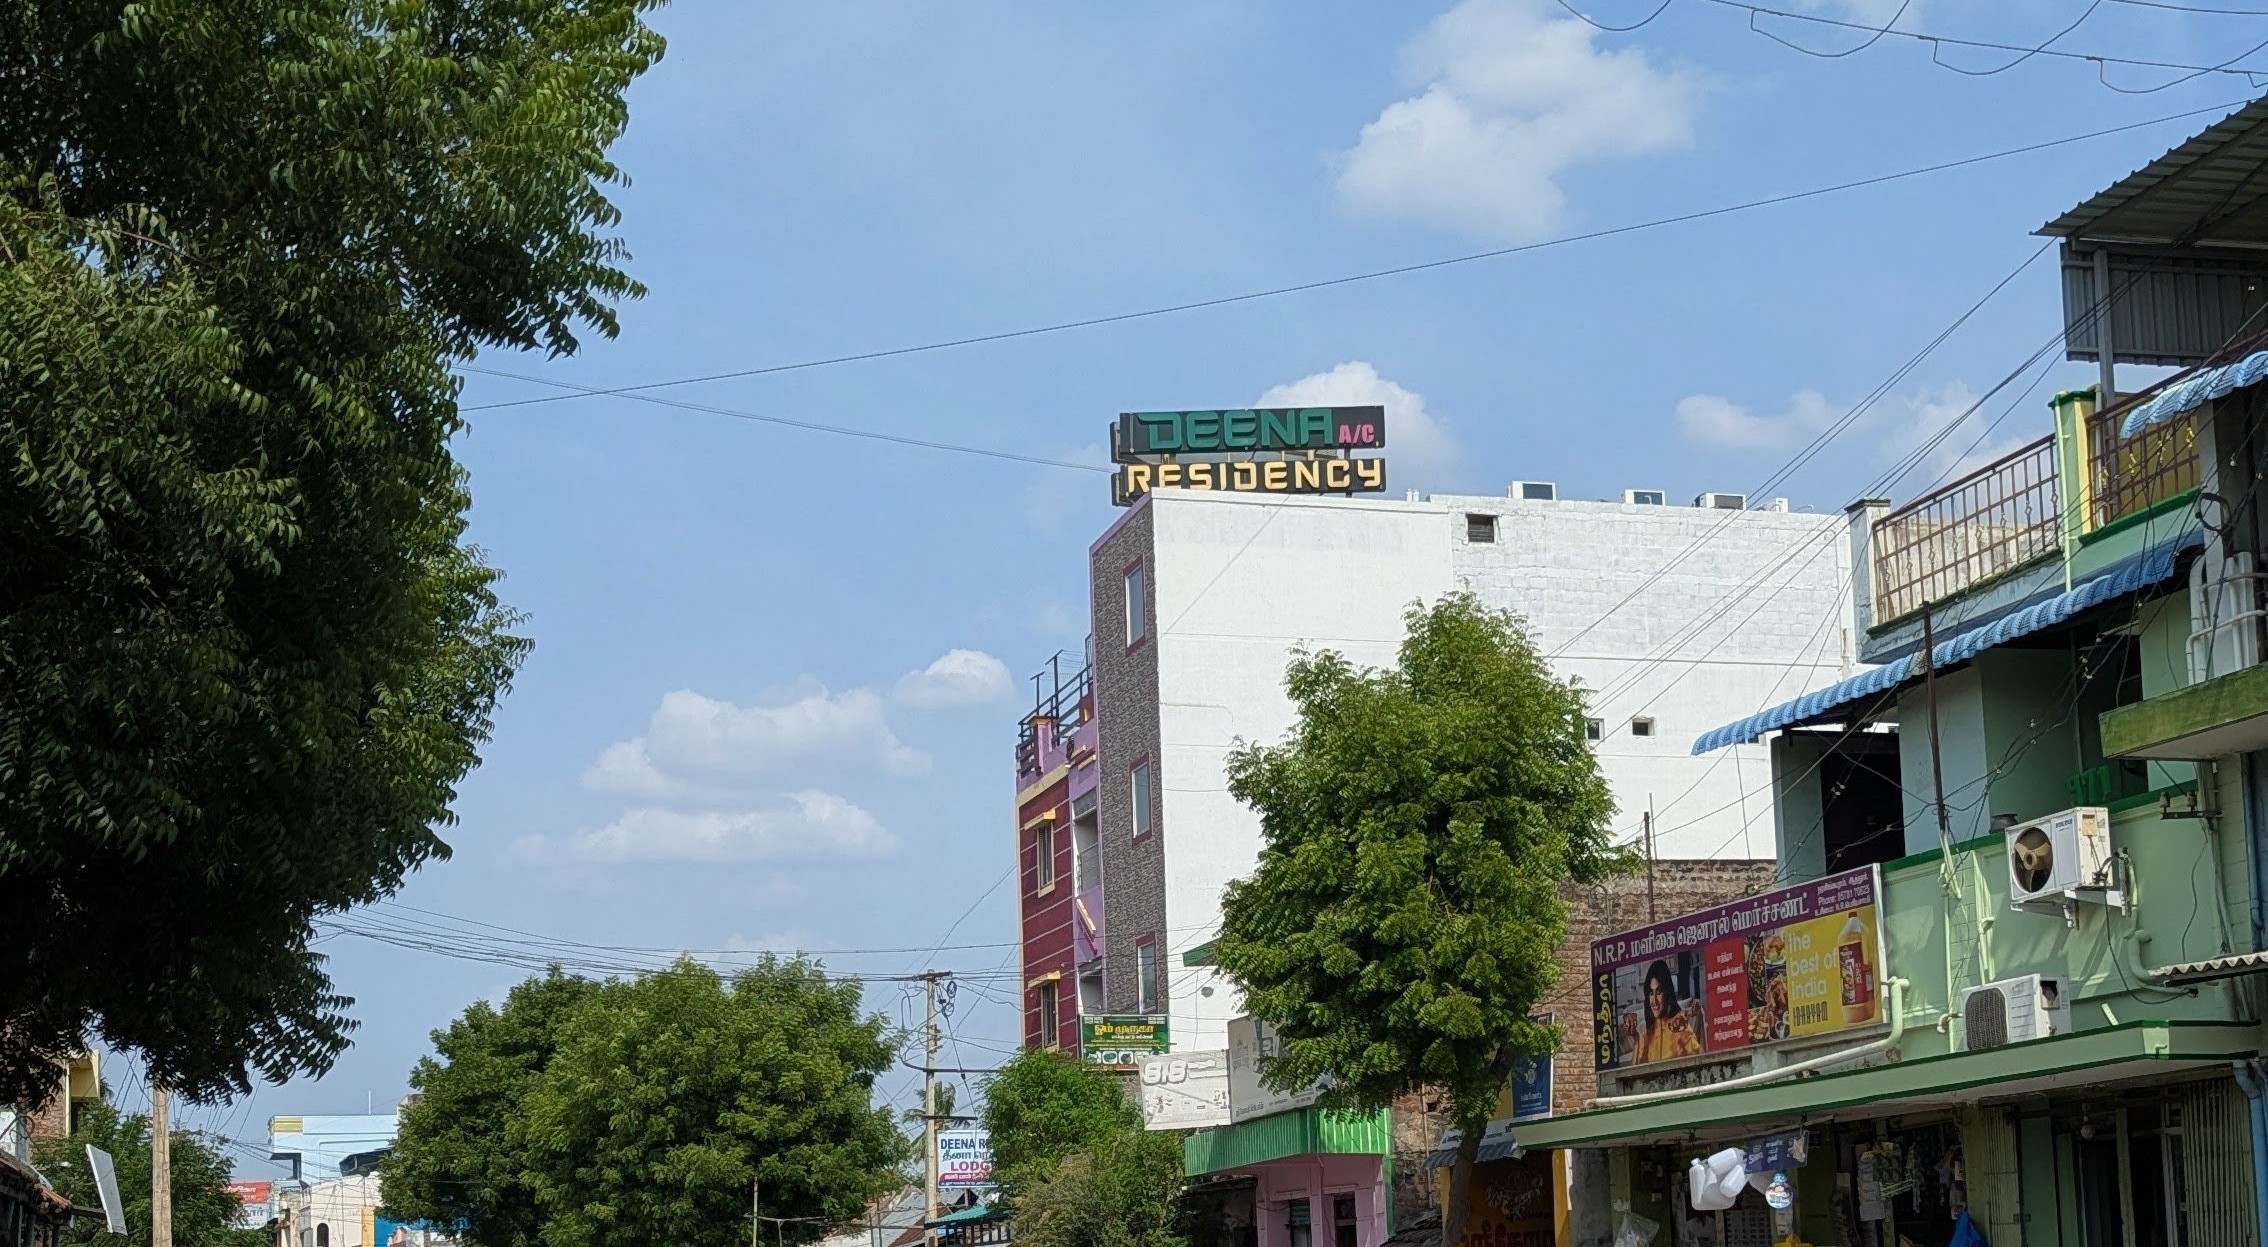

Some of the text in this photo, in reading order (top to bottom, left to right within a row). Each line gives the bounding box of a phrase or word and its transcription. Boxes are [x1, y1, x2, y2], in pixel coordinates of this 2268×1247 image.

[1137, 408, 1375, 449] DEENA A/C
[1126, 457, 1381, 493] RESIDENCY
[1594, 941, 1629, 966] N.R.P.
[1789, 933, 1810, 953] the
[1790, 952, 1819, 976] best
[940, 1138, 975, 1150] DEENA
